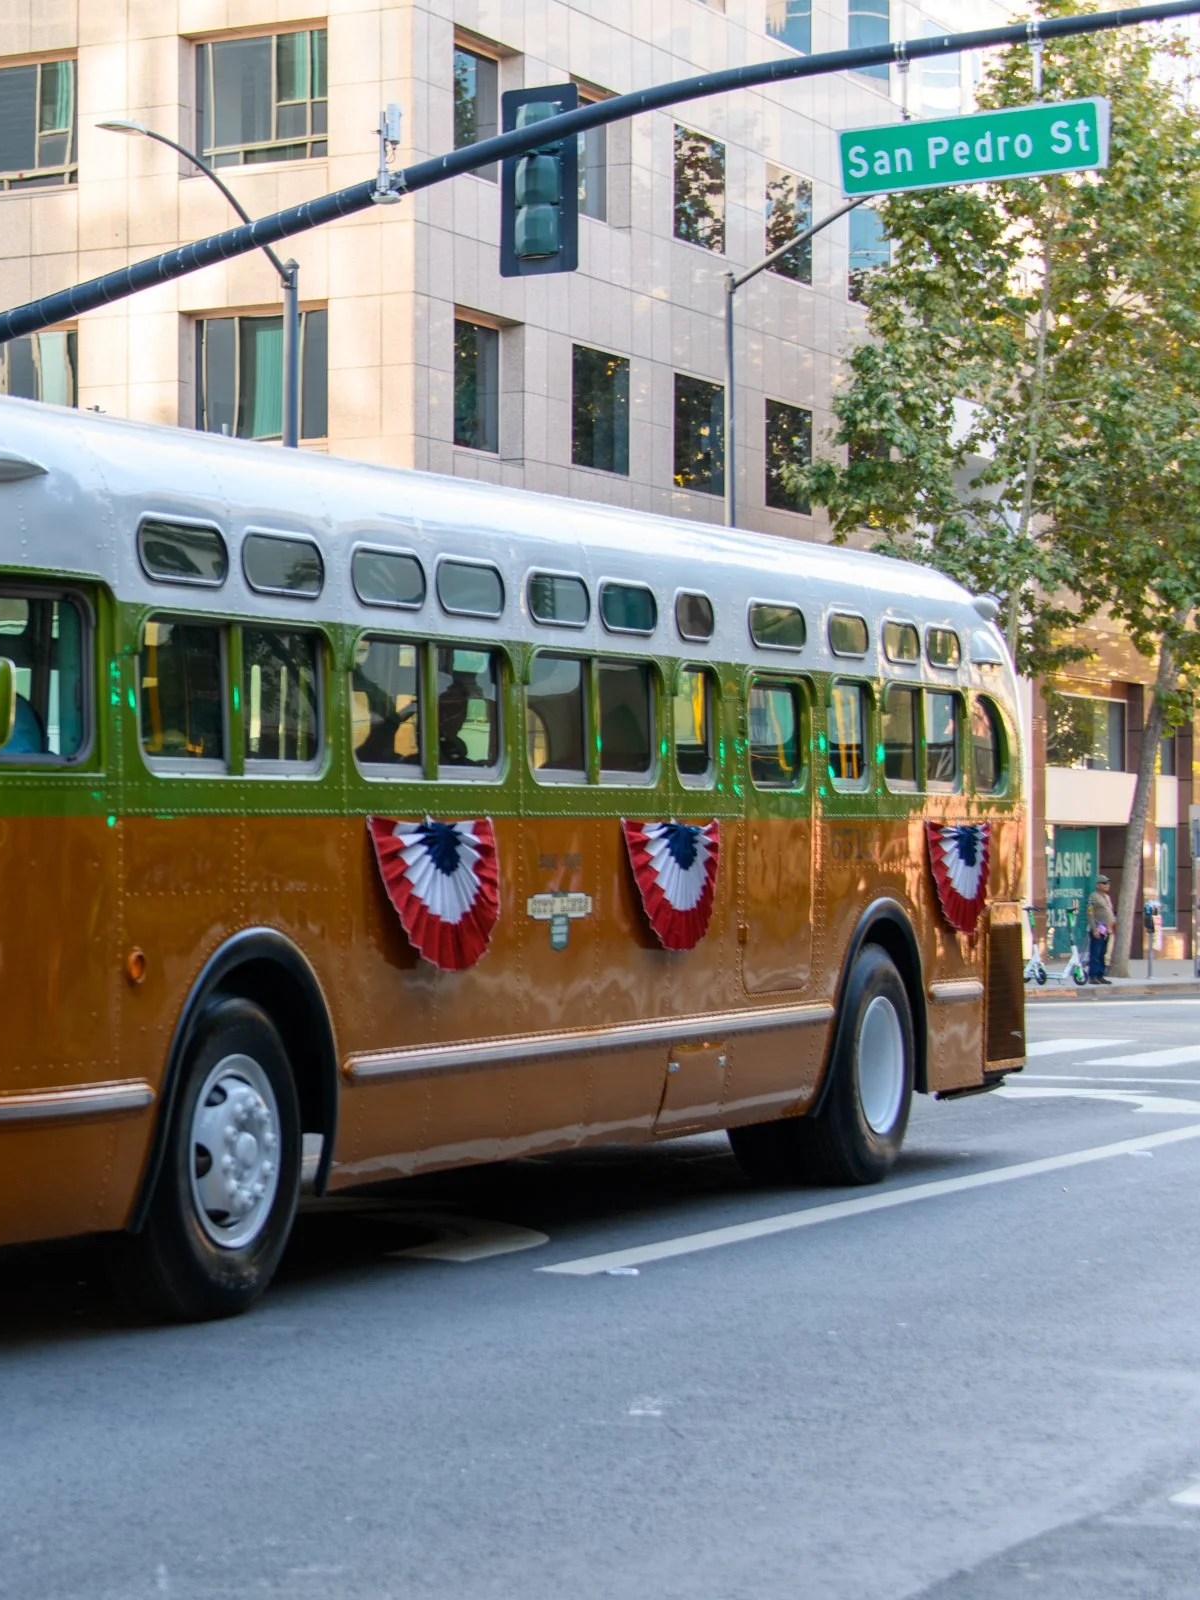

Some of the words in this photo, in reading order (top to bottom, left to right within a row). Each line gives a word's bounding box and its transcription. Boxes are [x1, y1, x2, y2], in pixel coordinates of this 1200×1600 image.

[848, 145, 913, 178] San
[927, 130, 1033, 169] Pedro
[1050, 118, 1091, 155] St
